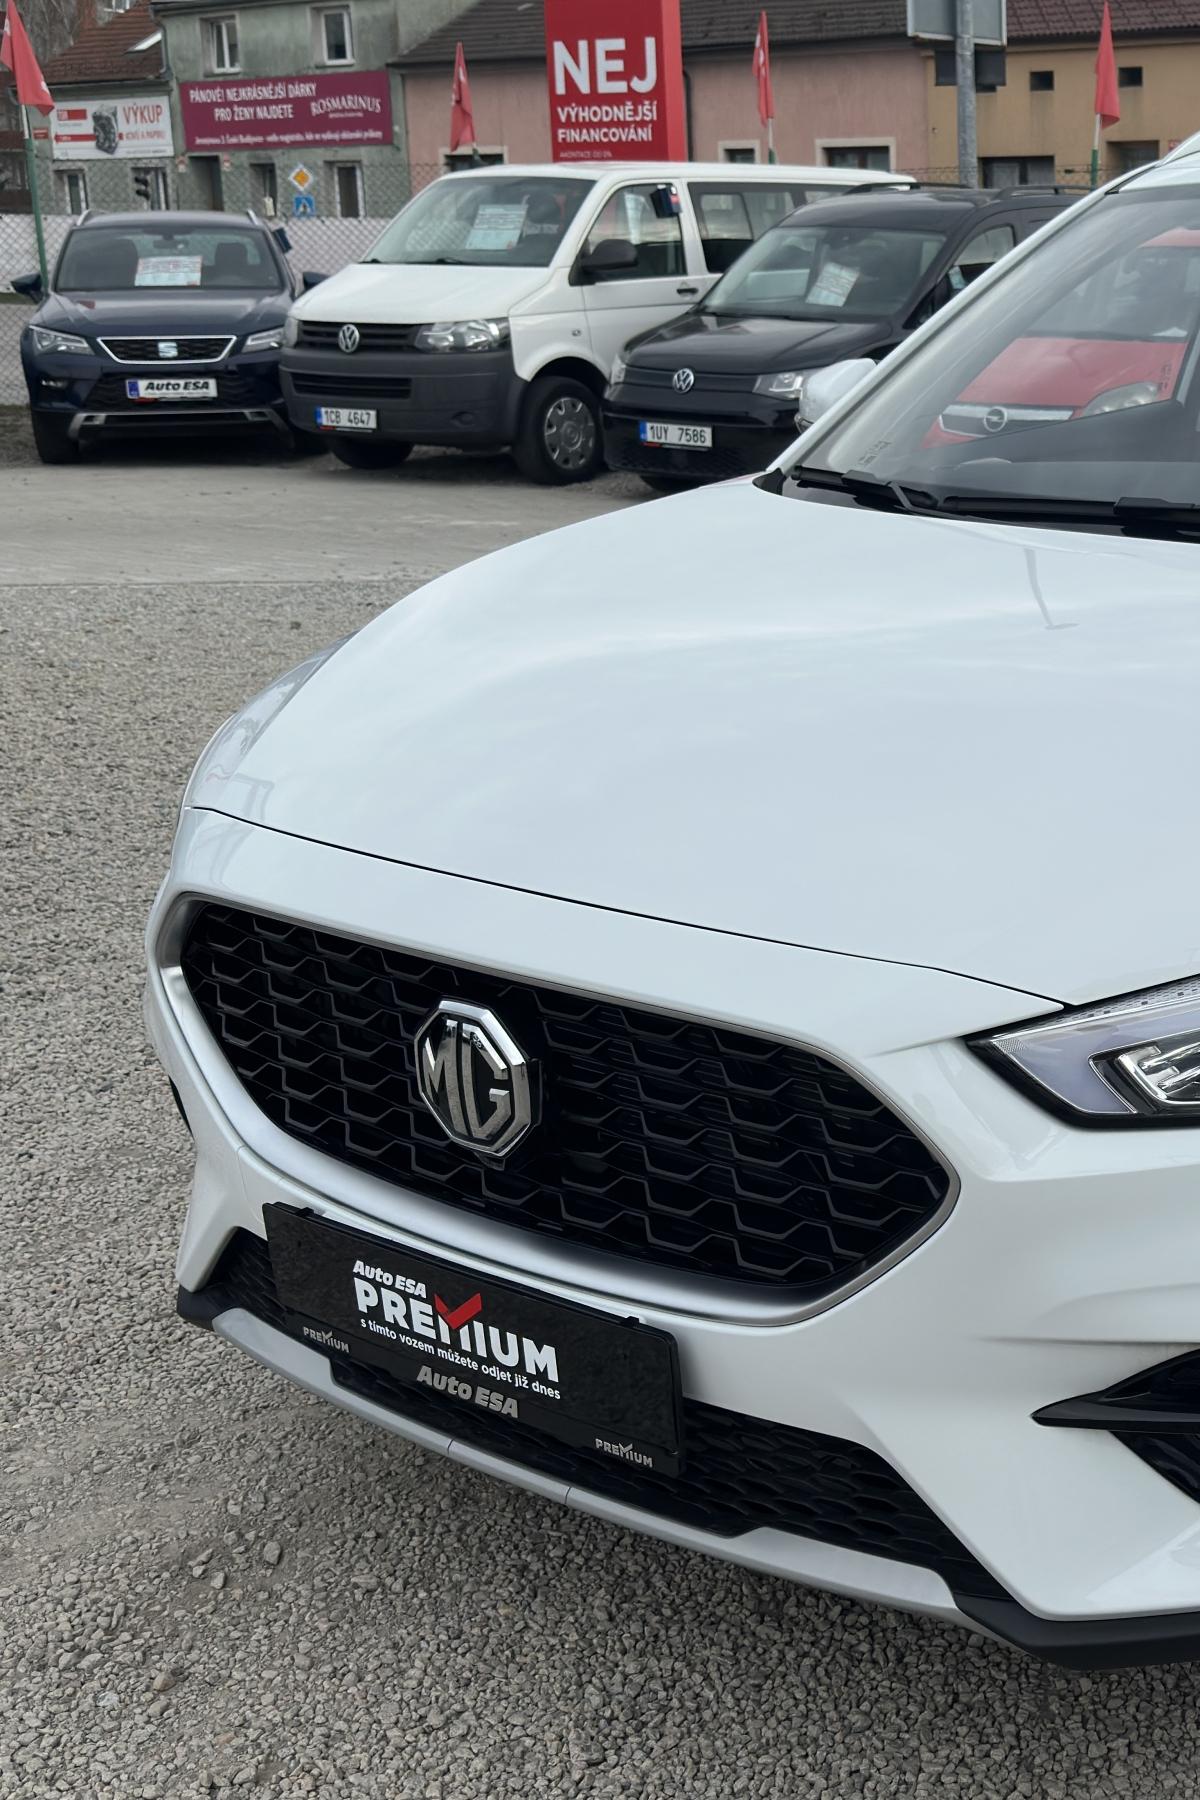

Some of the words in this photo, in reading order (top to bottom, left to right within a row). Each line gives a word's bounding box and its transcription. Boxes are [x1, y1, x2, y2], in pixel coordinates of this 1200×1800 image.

[553, 36, 657, 95] NEJ
[189, 86, 225, 103] PÁNOVÉ!
[226, 82, 287, 102] NEJKRÁSNĚJŠÍ
[288, 82, 317, 99] DÁRKY
[123, 102, 163, 125] VÝKUP
[214, 107, 232, 121] PRO
[234, 104, 255, 121] ŽENY
[256, 104, 294, 119] NAJDETE
[310, 95, 382, 116] ROSMARINUS
[557, 100, 657, 123] VÝHODNĚJŠÍ
[557, 124, 652, 143] FINANCOVÁNÍ
[145, 381, 181, 391] Auto
[183, 381, 209, 391] ESA
[324, 410, 341, 425] 1CB
[347, 411, 371, 426] 4647
[650, 425, 669, 441] 1UY
[677, 427, 706, 444] 7586
[422, 1018, 512, 1141] MG
[353, 1259, 394, 1287] Auto
[395, 1274, 427, 1298] ESA
[303, 1326, 350, 1353] PREMIUM
[353, 1276, 560, 1383] PREMIUM
[360, 1318, 367, 1328] s
[399, 1333, 435, 1355] vozem
[437, 1345, 479, 1371] můžete
[481, 1363, 512, 1384] odjet
[514, 1372, 529, 1389] již
[531, 1381, 561, 1400] dnes
[416, 1365, 473, 1400] Auto
[474, 1386, 519, 1418] ESA
[595, 1438, 653, 1468] PREMIUM
